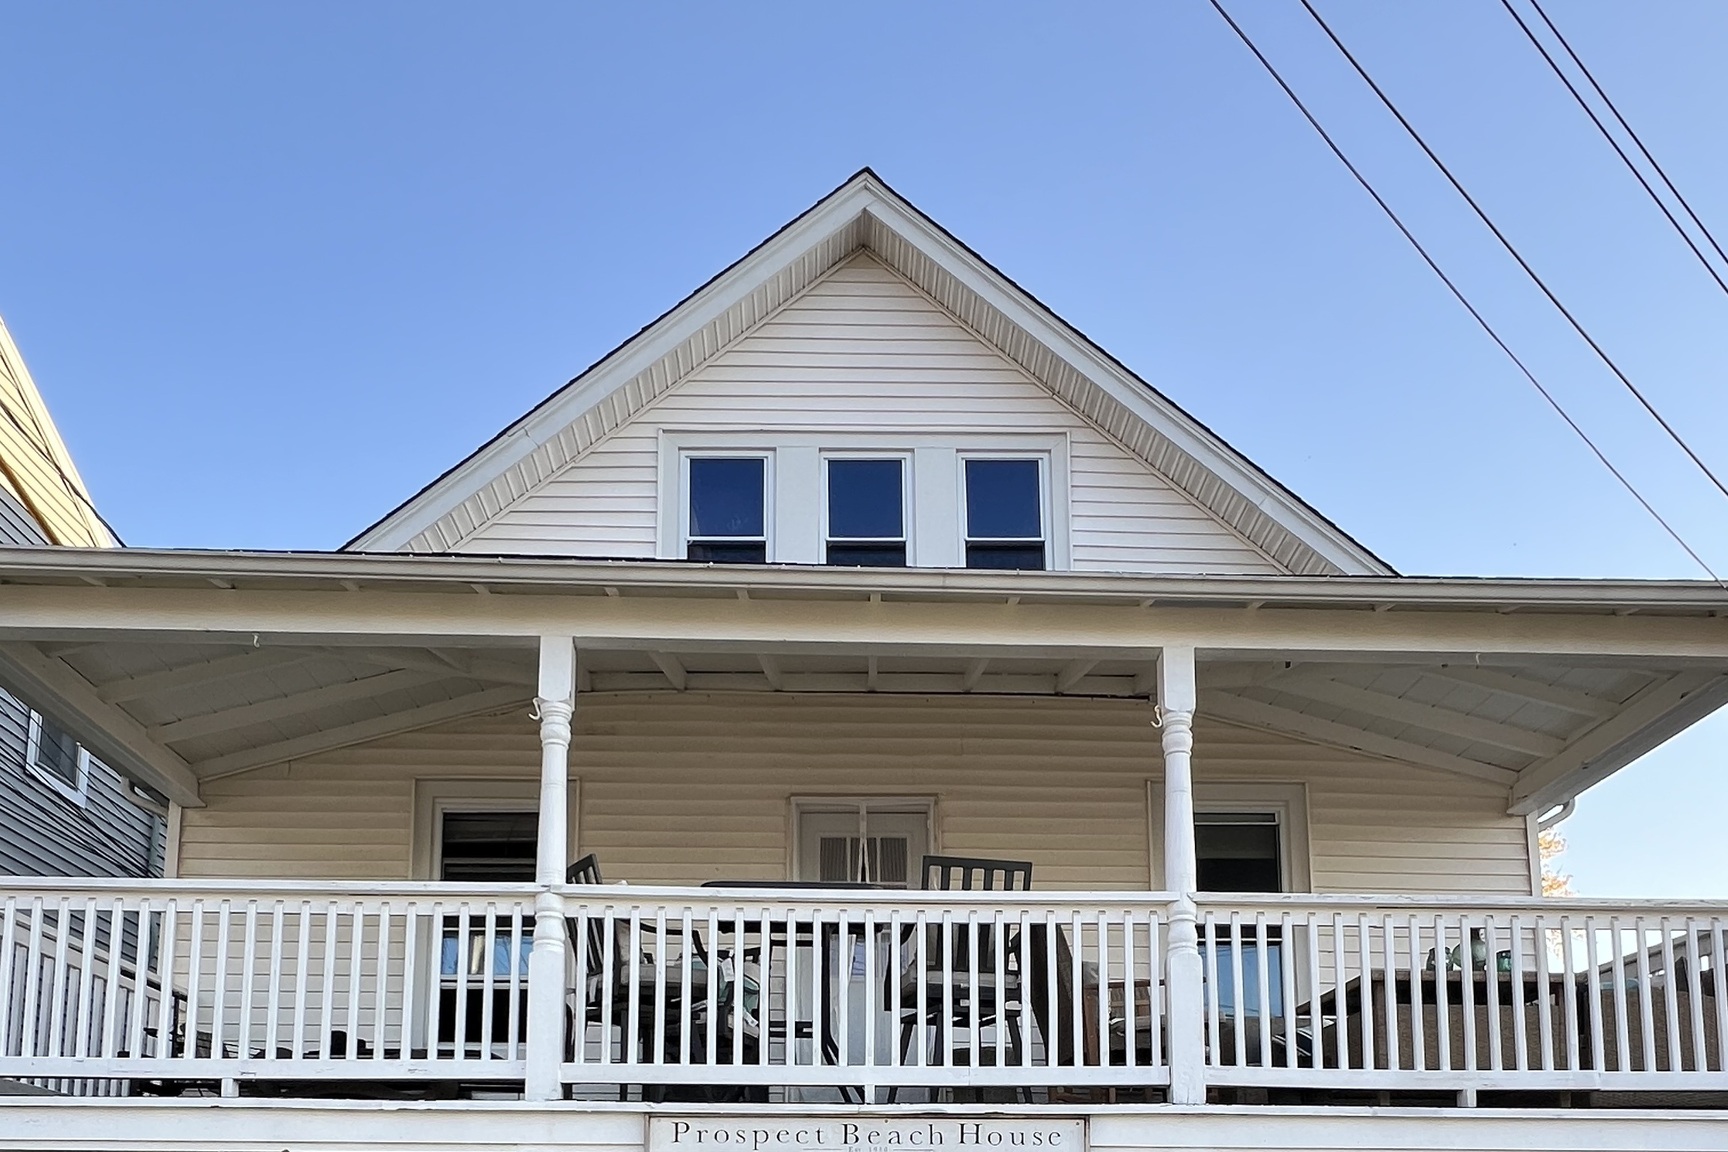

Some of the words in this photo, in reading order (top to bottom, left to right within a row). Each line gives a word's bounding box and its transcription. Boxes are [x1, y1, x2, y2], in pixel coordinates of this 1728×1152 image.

[671, 1121, 825, 1151] Prospect
[841, 1123, 944, 1145] Beach
[958, 1123, 1062, 1147] House
